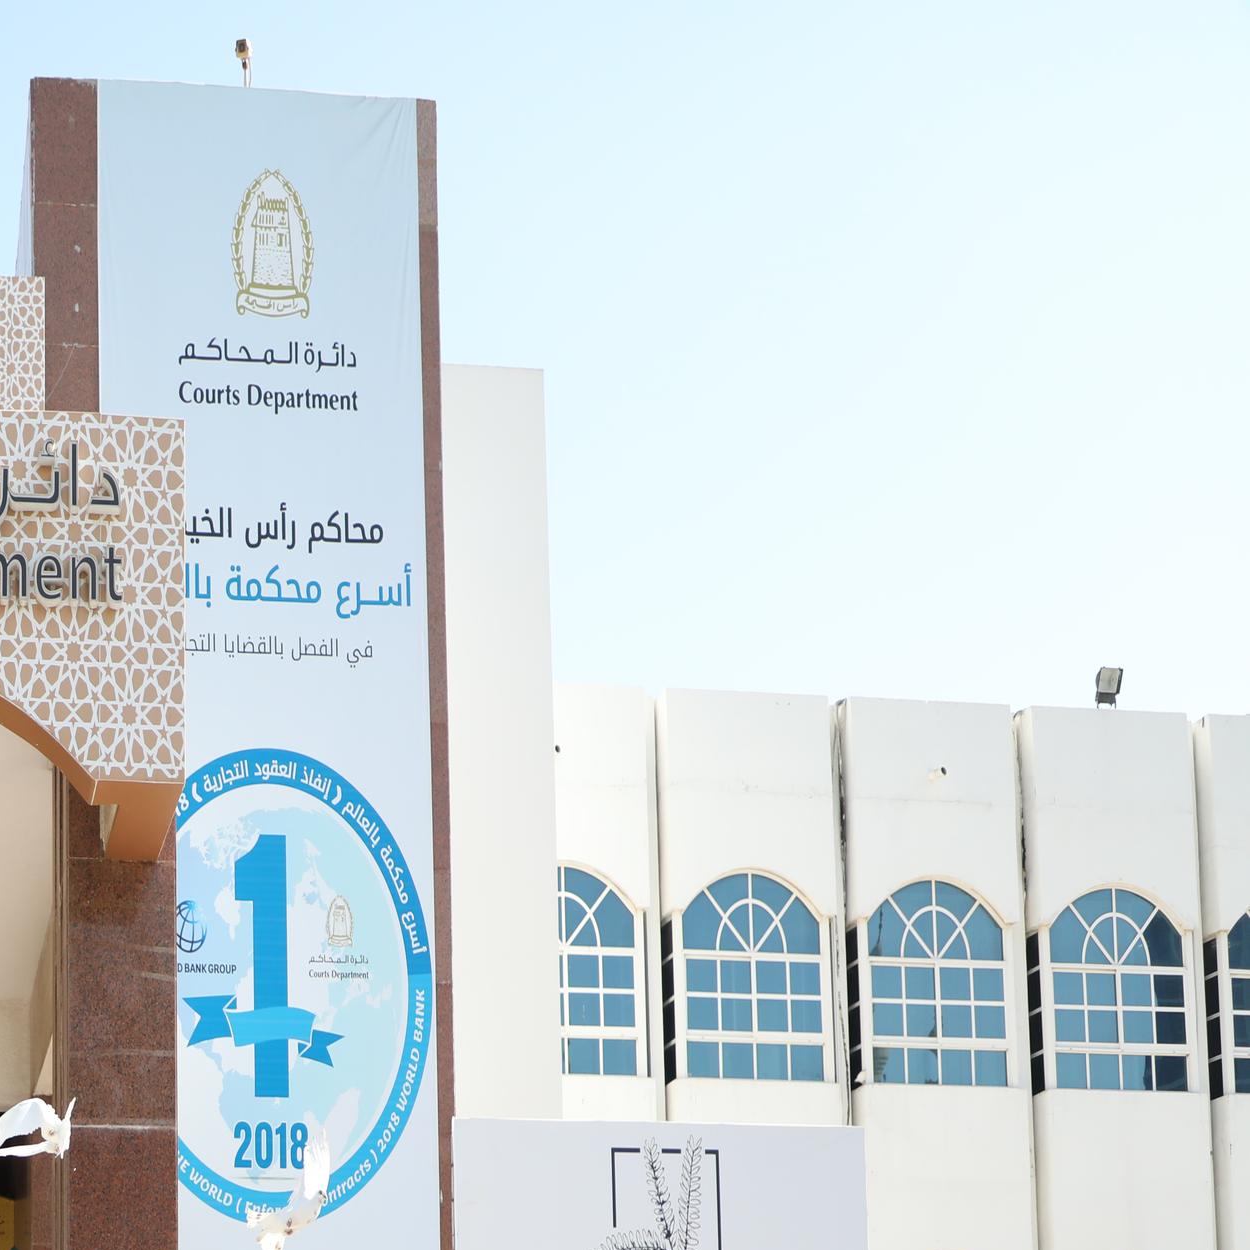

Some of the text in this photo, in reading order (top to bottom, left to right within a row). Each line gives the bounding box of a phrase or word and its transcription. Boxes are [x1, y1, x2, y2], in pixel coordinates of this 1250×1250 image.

[178, 337, 357, 373] دائرة المحاكم
[179, 381, 358, 414] Courts Department
[245, 502, 296, 549] رأس
[308, 510, 384, 553] محاكم
[225, 564, 321, 603] محكمة
[336, 563, 411, 618] أسرع
[225, 633, 283, 659] بالقضايا
[291, 636, 338, 661] الفصل
[347, 638, 373, 668] في
[203, 760, 249, 793] التجارية
[254, 760, 297, 780] العقود
[341, 801, 381, 848] بالعالم
[380, 845, 408, 904] محكمة
[402, 911, 428, 955] أسرع
[184, 963, 207, 974] BANK
[208, 963, 237, 975] GROUP
[234, 834, 290, 1097] 1
[309, 970, 369, 981] Courts Department
[189, 1167, 233, 1207] WORLD
[377, 1111, 400, 1153] 2018
[396, 1047, 421, 1112] WORLD
[413, 988, 426, 1044] BANK
[234, 1121, 309, 1169] 2018
